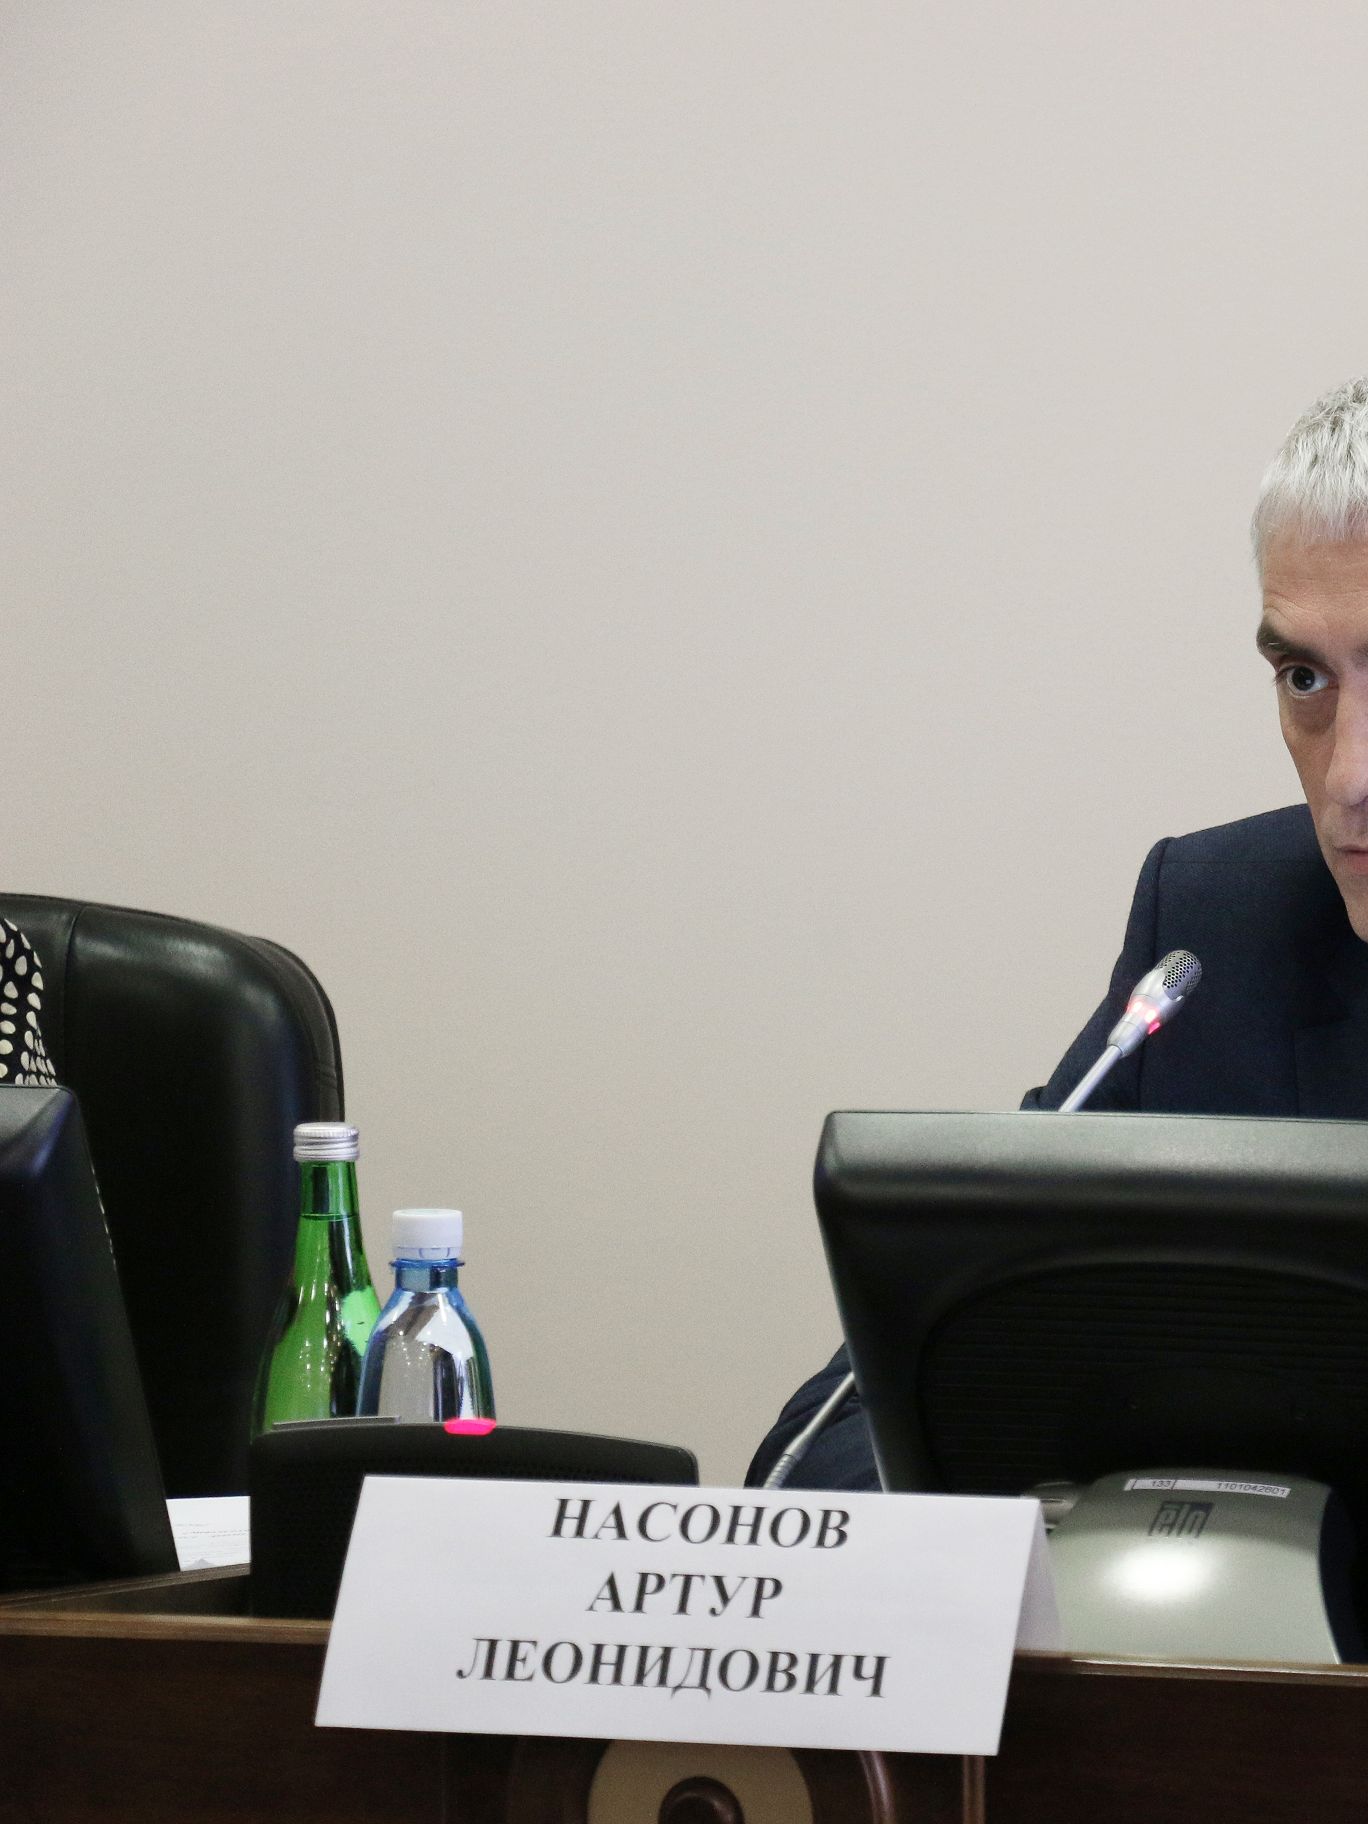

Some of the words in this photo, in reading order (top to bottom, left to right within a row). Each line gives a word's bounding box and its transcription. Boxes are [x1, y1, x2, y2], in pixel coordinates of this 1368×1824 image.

[1151, 1479, 1171, 1489] 133
[548, 1497, 851, 1549] НАСОНОВ
[586, 1572, 783, 1618] АРТУР
[456, 1638, 891, 1699] ЛЕОНИДОВИЧ
